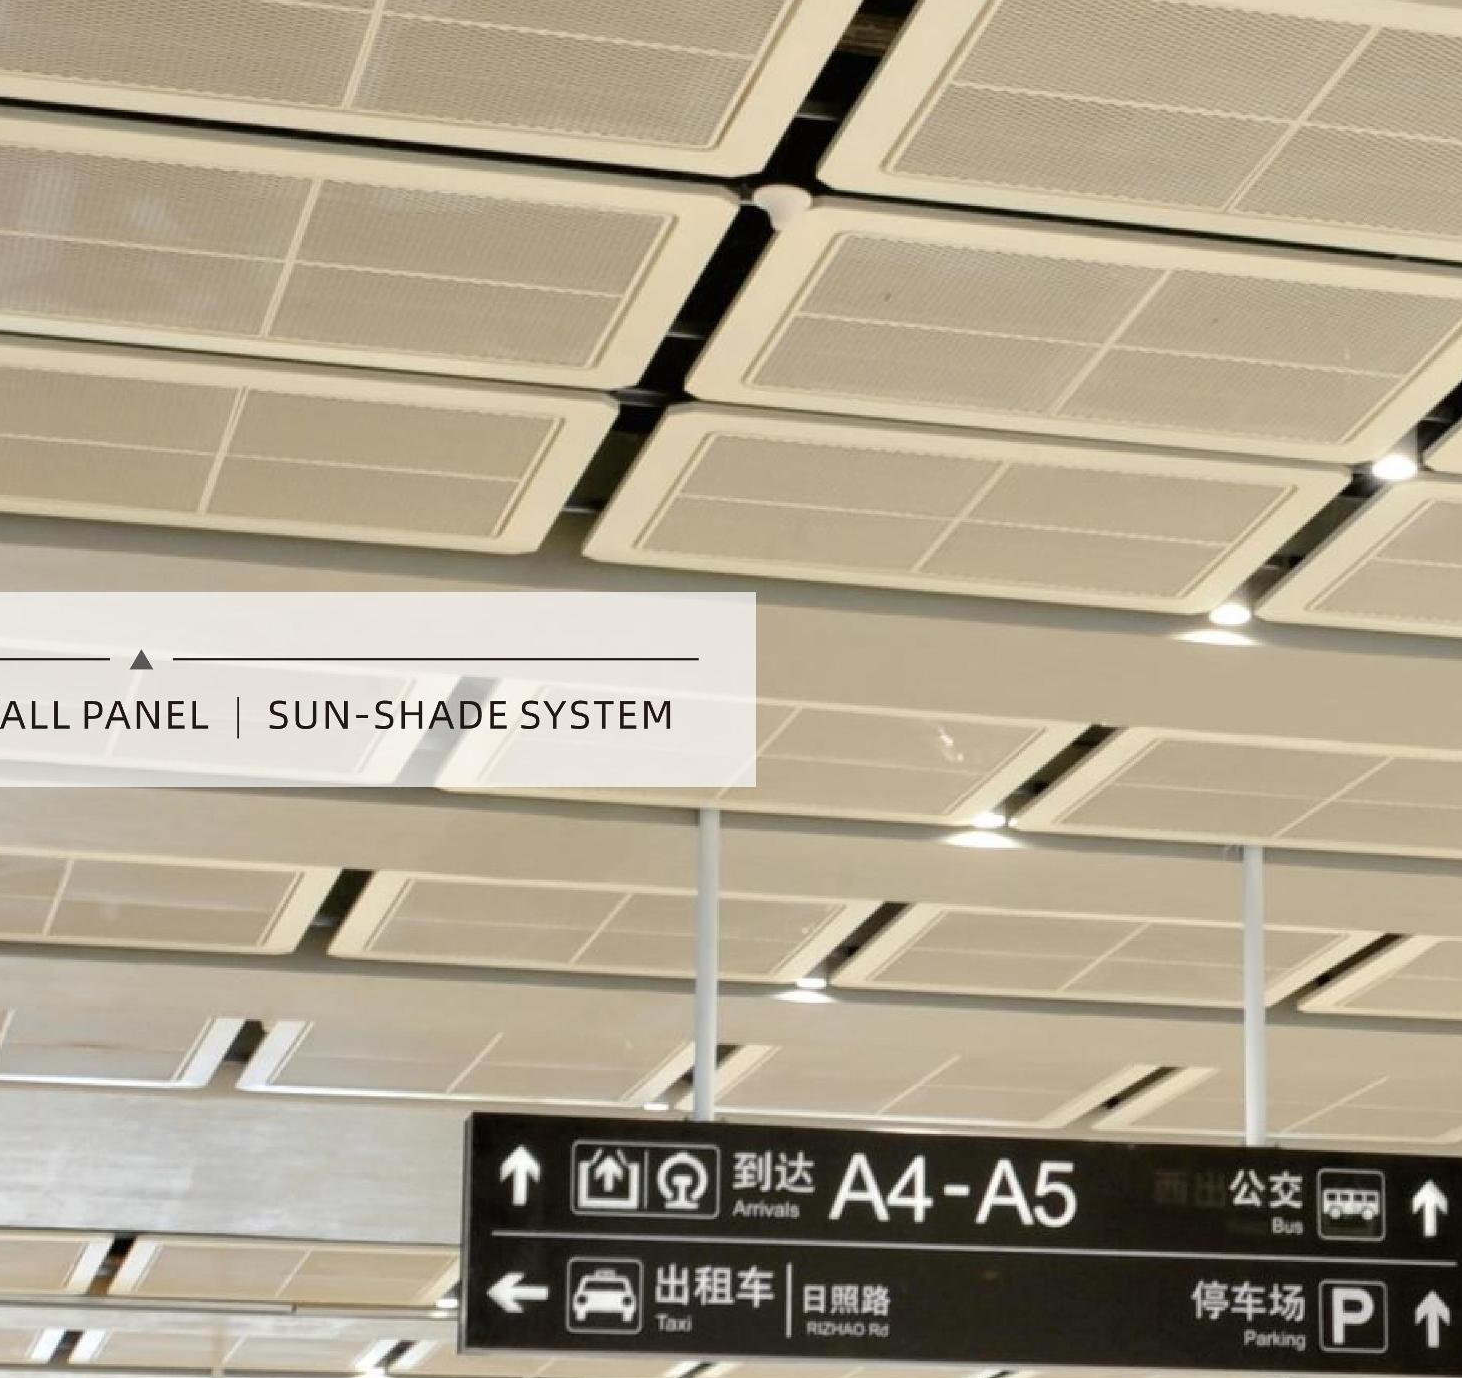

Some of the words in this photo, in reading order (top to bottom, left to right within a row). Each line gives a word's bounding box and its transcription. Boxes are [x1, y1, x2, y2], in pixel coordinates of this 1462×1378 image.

[731, 1150, 816, 1193] 到达
[828, 1152, 1078, 1228] A4-A5
[1228, 1168, 1304, 1209] 公交
[732, 1200, 801, 1219] Arrivals
[1272, 1217, 1304, 1235] Bus
[654, 1263, 775, 1309] 出租车
[802, 1283, 891, 1317] 日照路
[1191, 1280, 1307, 1323] 停车场
[655, 1313, 693, 1333] Taxi
[1243, 1329, 1307, 1352] Parking
